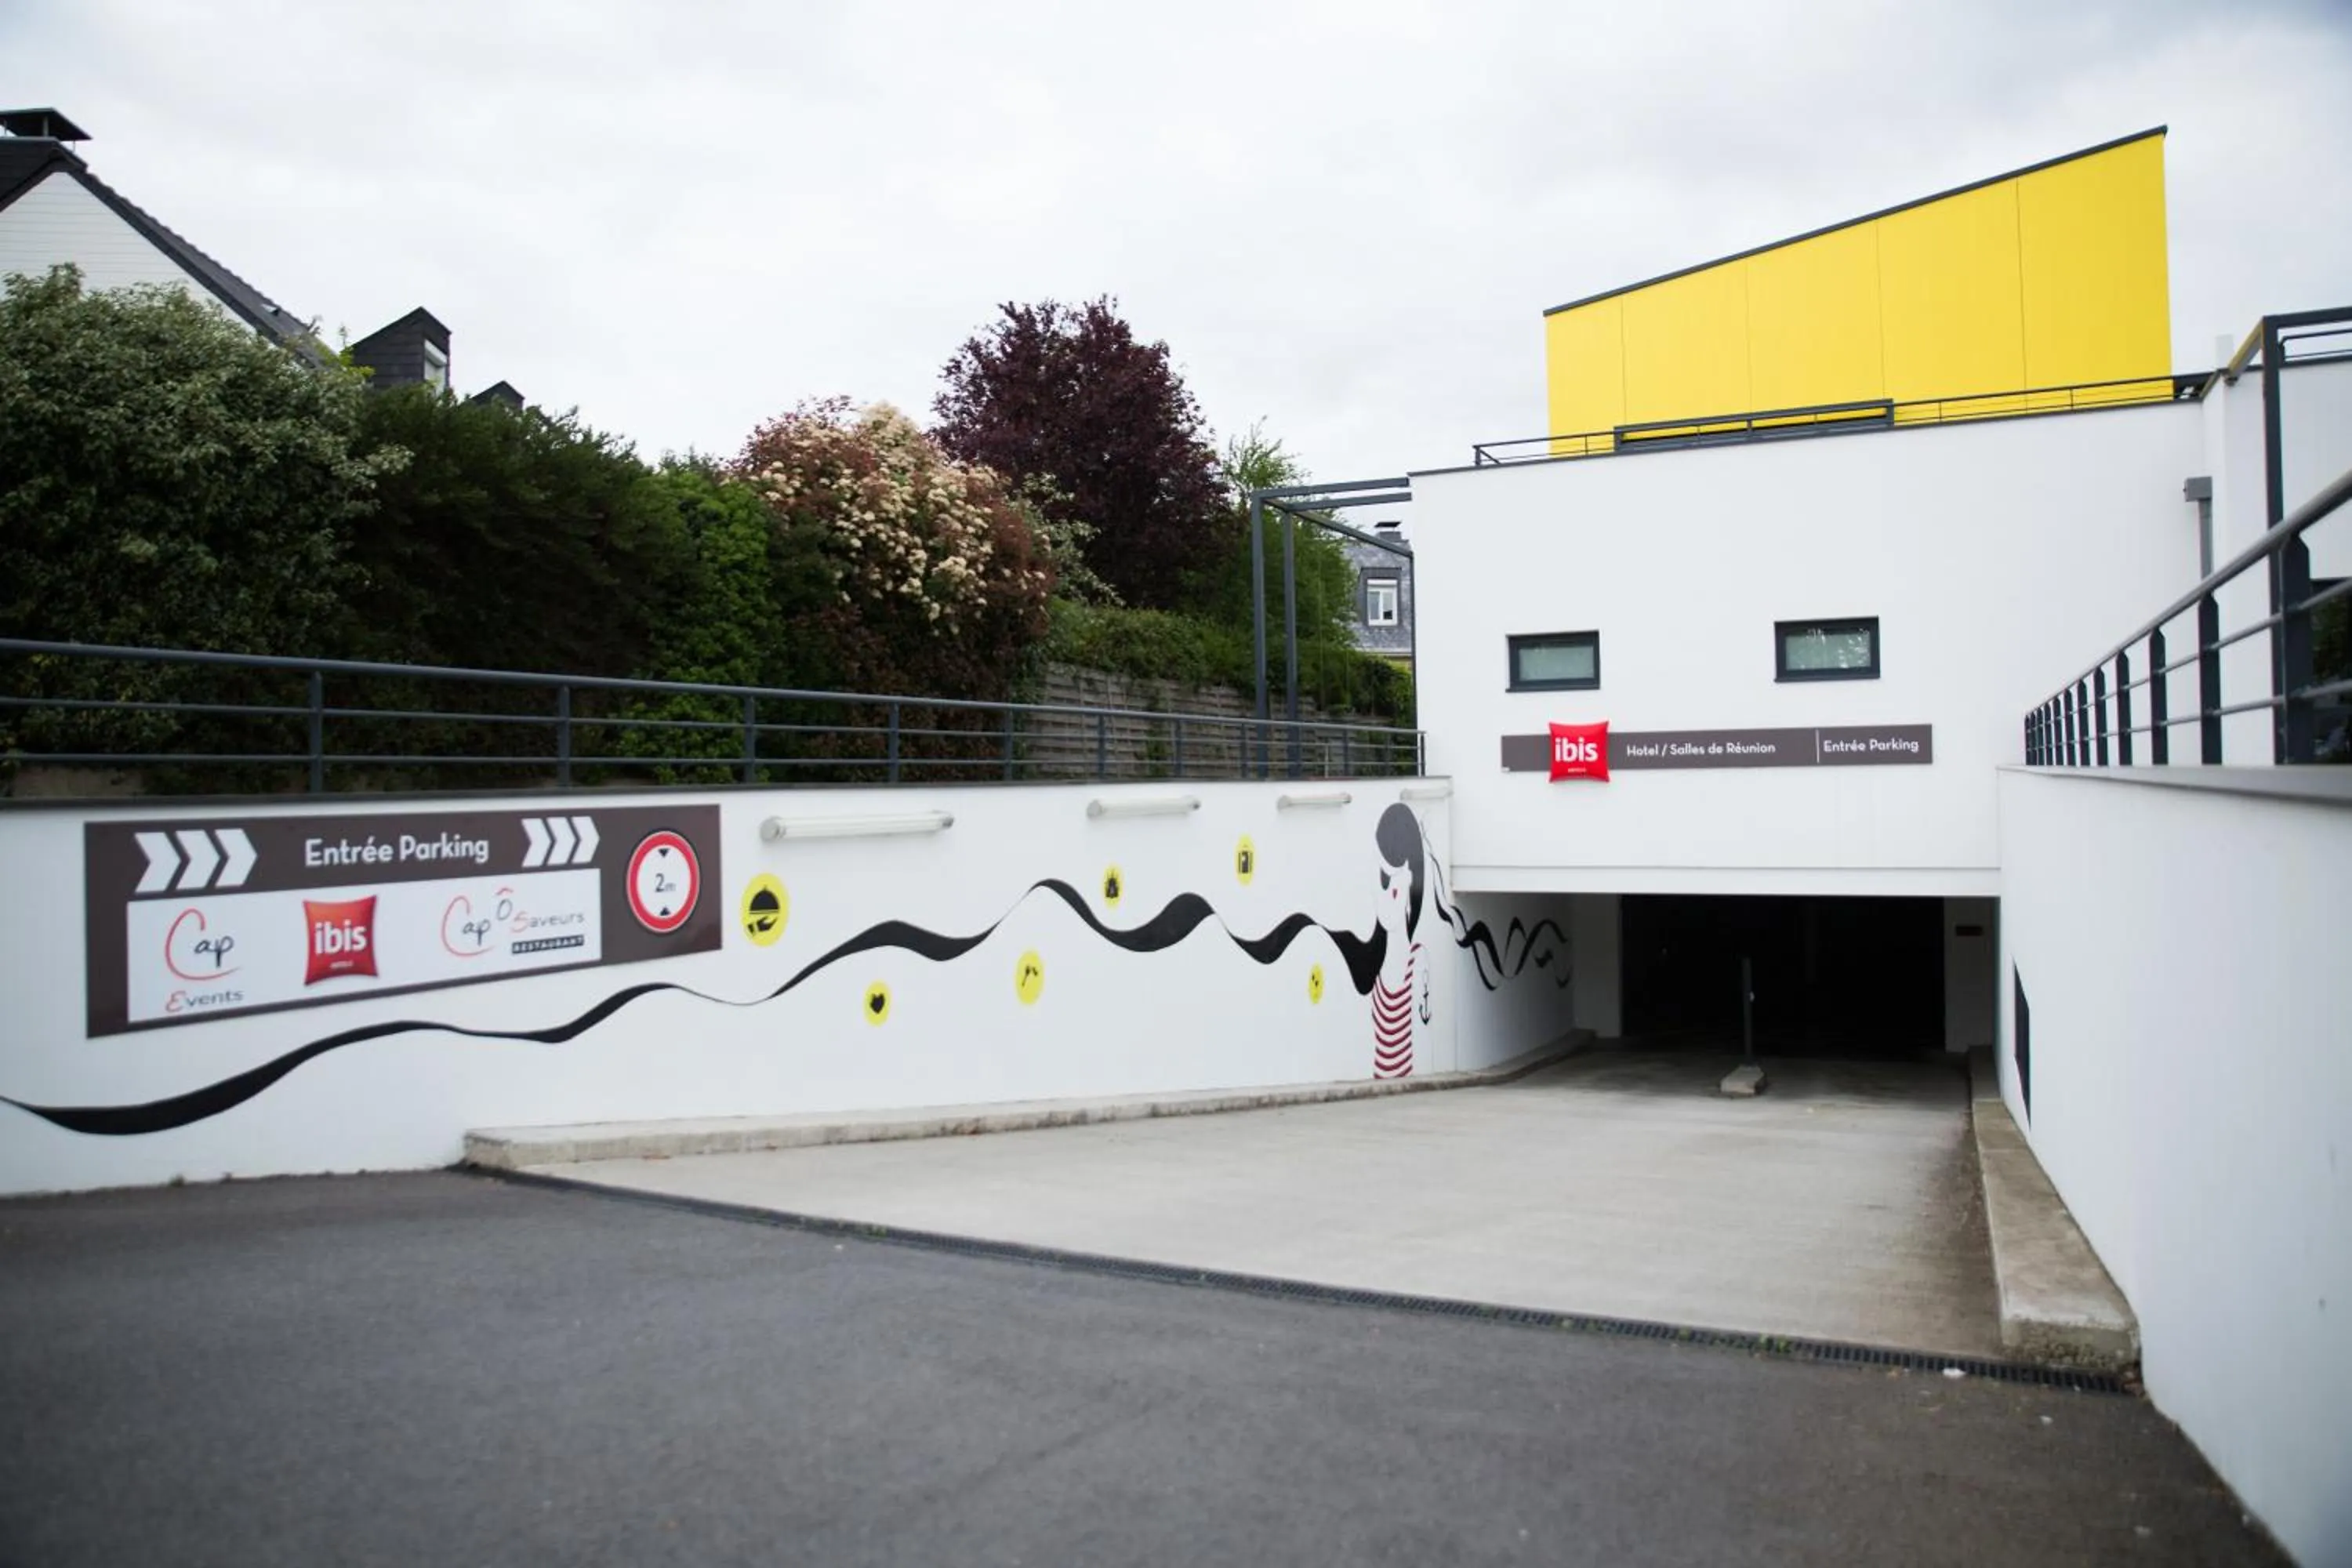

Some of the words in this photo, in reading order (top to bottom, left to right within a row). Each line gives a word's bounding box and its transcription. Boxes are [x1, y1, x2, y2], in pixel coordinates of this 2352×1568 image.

[1555, 737, 1599, 762] ibis
[1627, 745, 1658, 757] Hotel
[1670, 744, 1704, 756] Salles
[1708, 743, 1722, 755] de
[1727, 741, 1776, 754] Réunion
[1823, 739, 1866, 753] Entrée
[1869, 737, 1919, 753] Parking
[305, 836, 394, 866] Entrée
[399, 832, 489, 863] Parking
[315, 919, 367, 954] ibis
[442, 895, 495, 957] Cap
[511, 911, 585, 933] Saveurs
[165, 909, 242, 981] Cap
[165, 990, 244, 1013] Events
